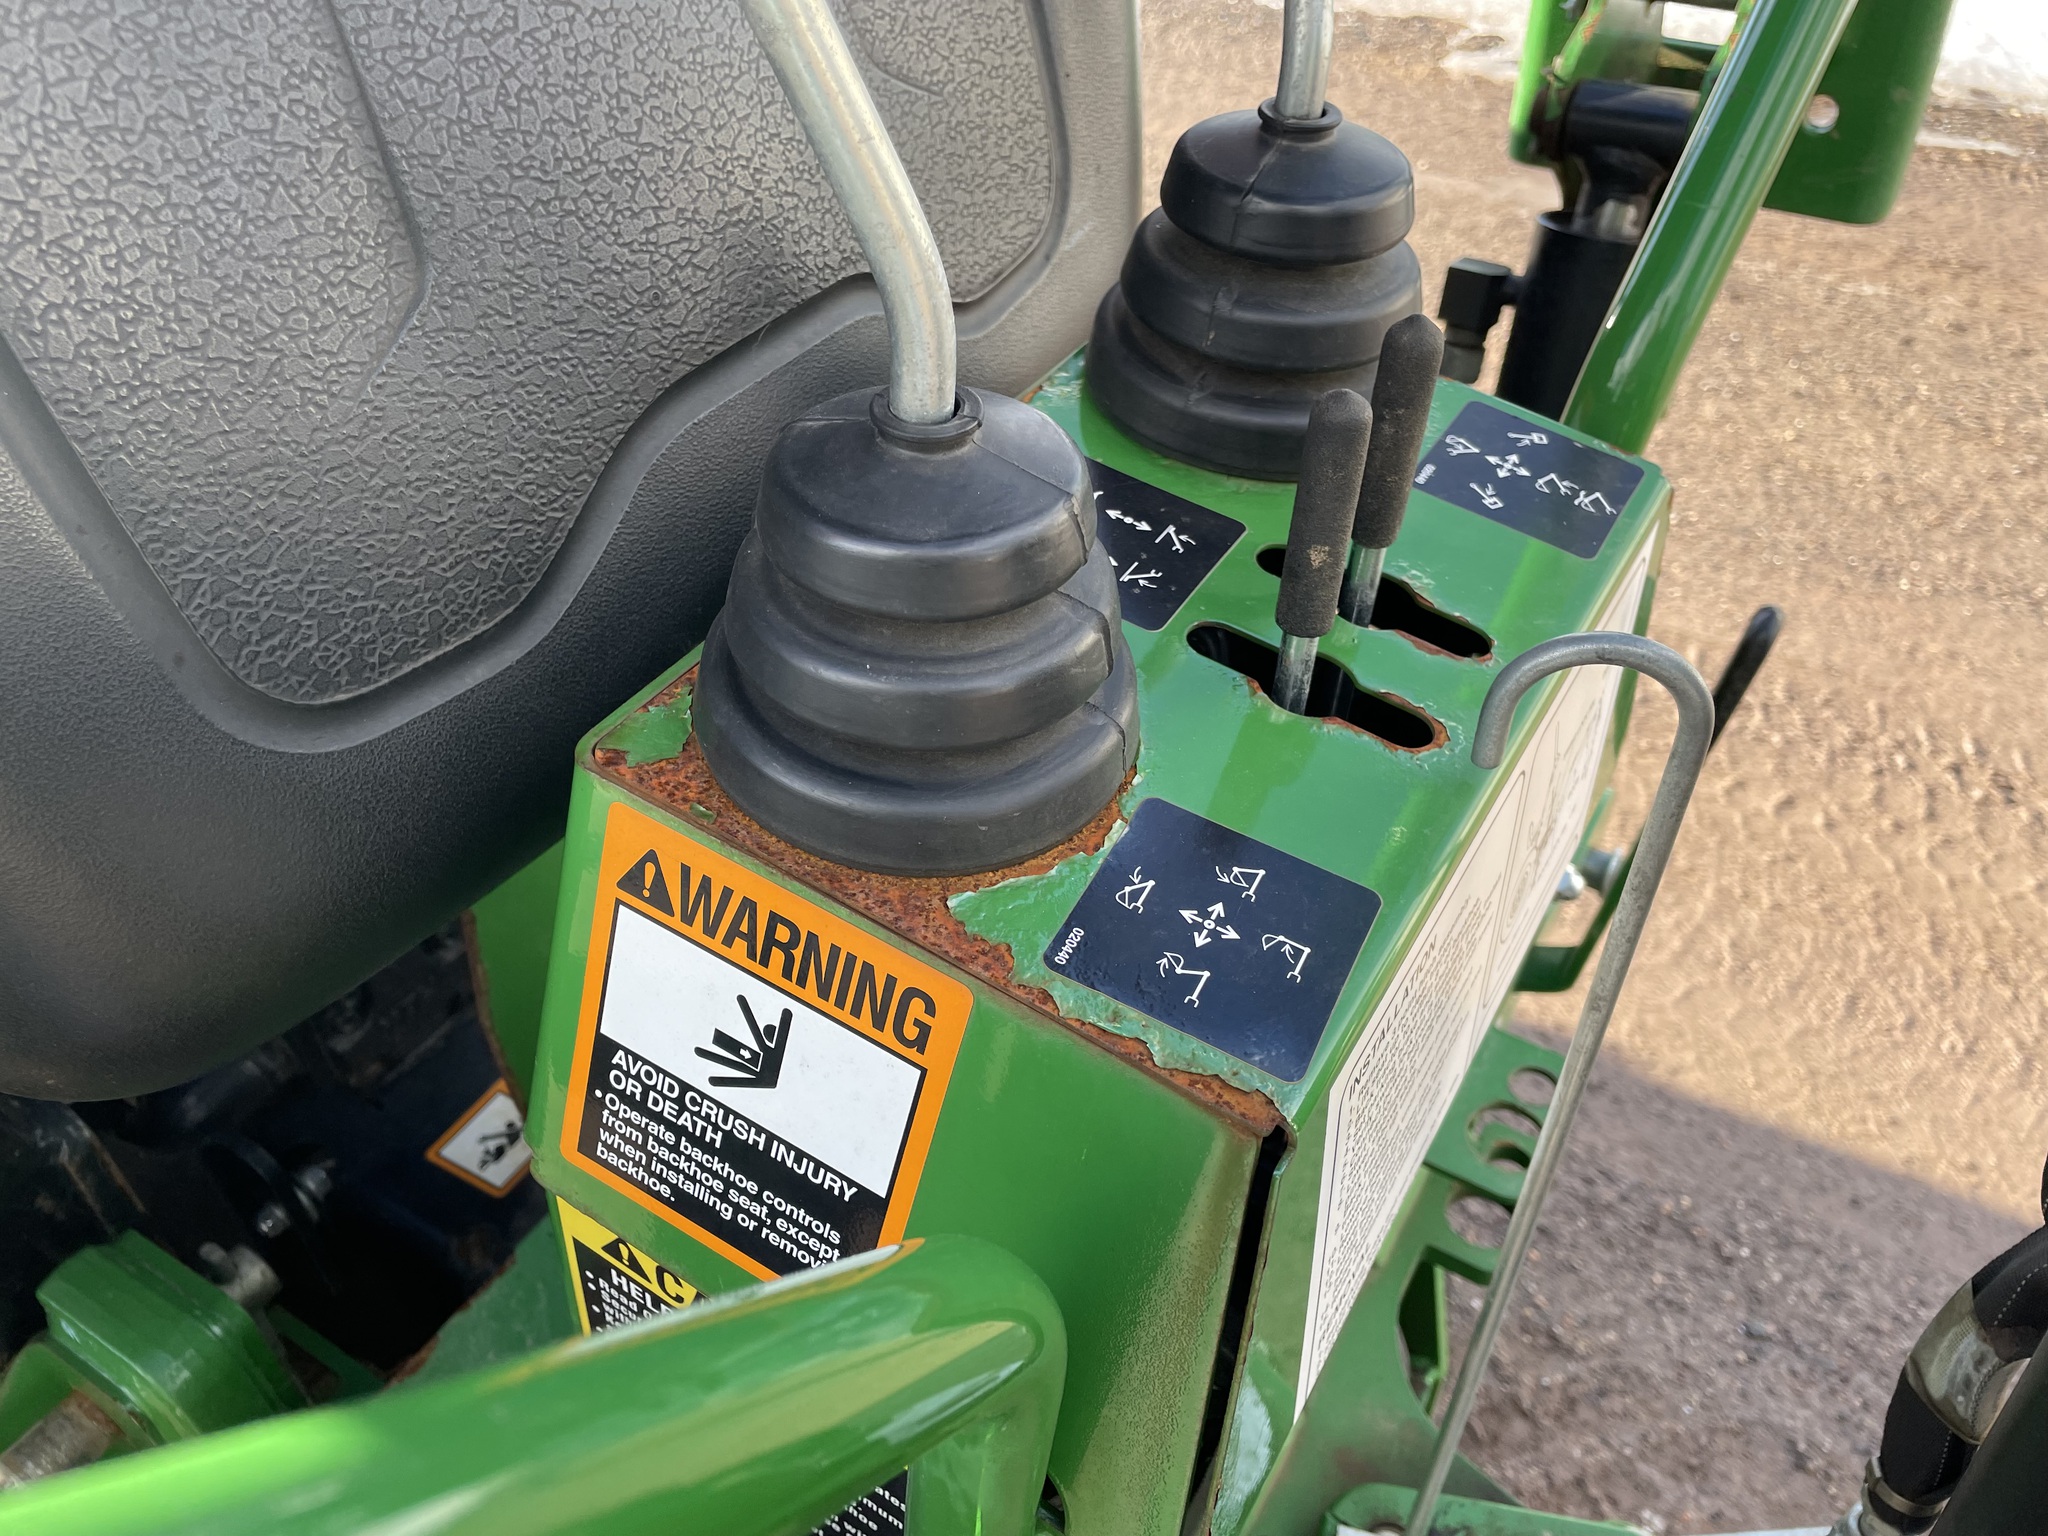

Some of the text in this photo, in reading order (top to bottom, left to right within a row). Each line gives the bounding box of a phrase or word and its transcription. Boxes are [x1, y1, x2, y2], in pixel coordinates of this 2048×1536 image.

[680, 862, 936, 1055] WARNING
[1054, 927, 1085, 965] 020440
[1349, 935, 1438, 1101] INSTALLATION
[596, 1142, 675, 1202] backhoe.
[605, 1092, 841, 1245] Operate backhoe controls
[609, 1069, 723, 1149] OR DEATH
[611, 1049, 858, 1202] AVOID CRUSH INJURY
[599, 1127, 826, 1268] when installing or remov
[602, 1109, 841, 1263] from backhoe seat, except
[599, 1278, 638, 1312] Read
[601, 1290, 641, 1322] Secu
